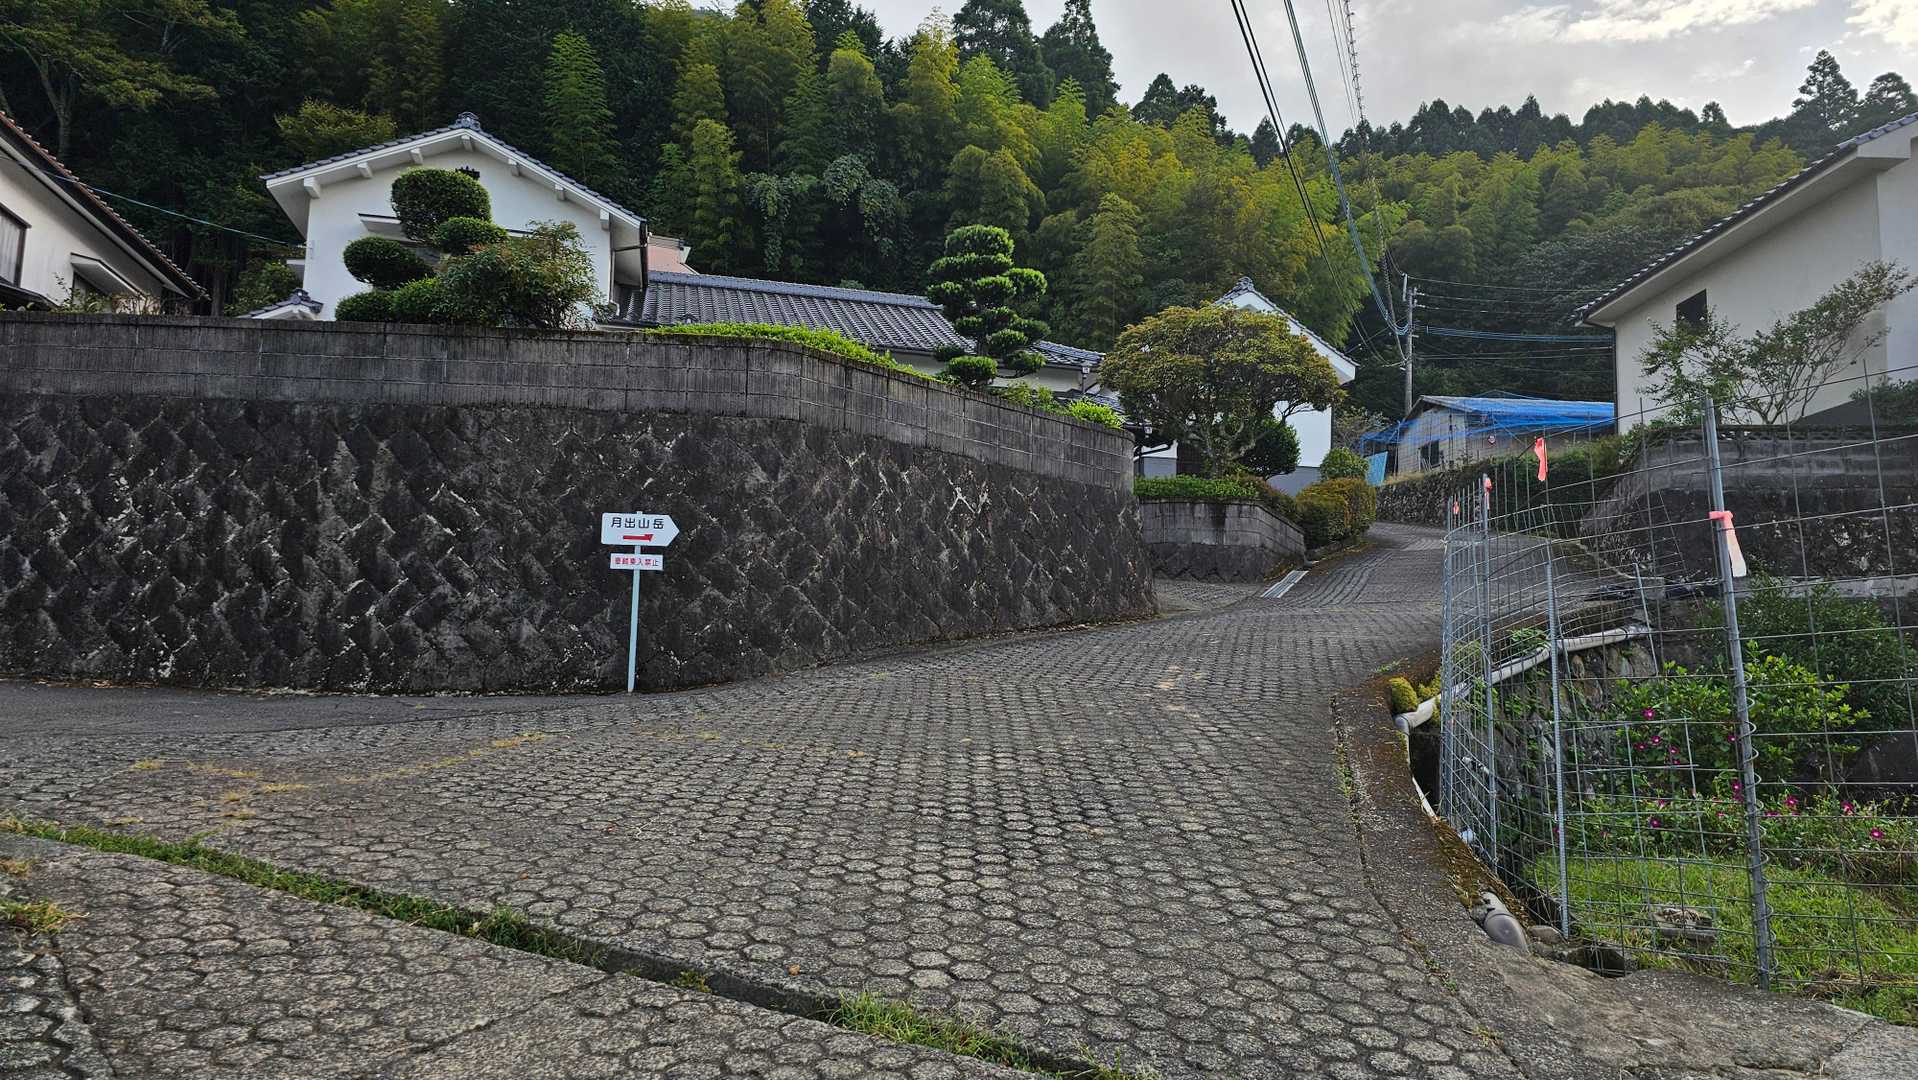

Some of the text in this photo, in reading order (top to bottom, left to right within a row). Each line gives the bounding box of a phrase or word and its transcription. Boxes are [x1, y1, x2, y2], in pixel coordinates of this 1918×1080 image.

[611, 517, 664, 529] 月出山岳
[615, 557, 659, 567] 入禁止
